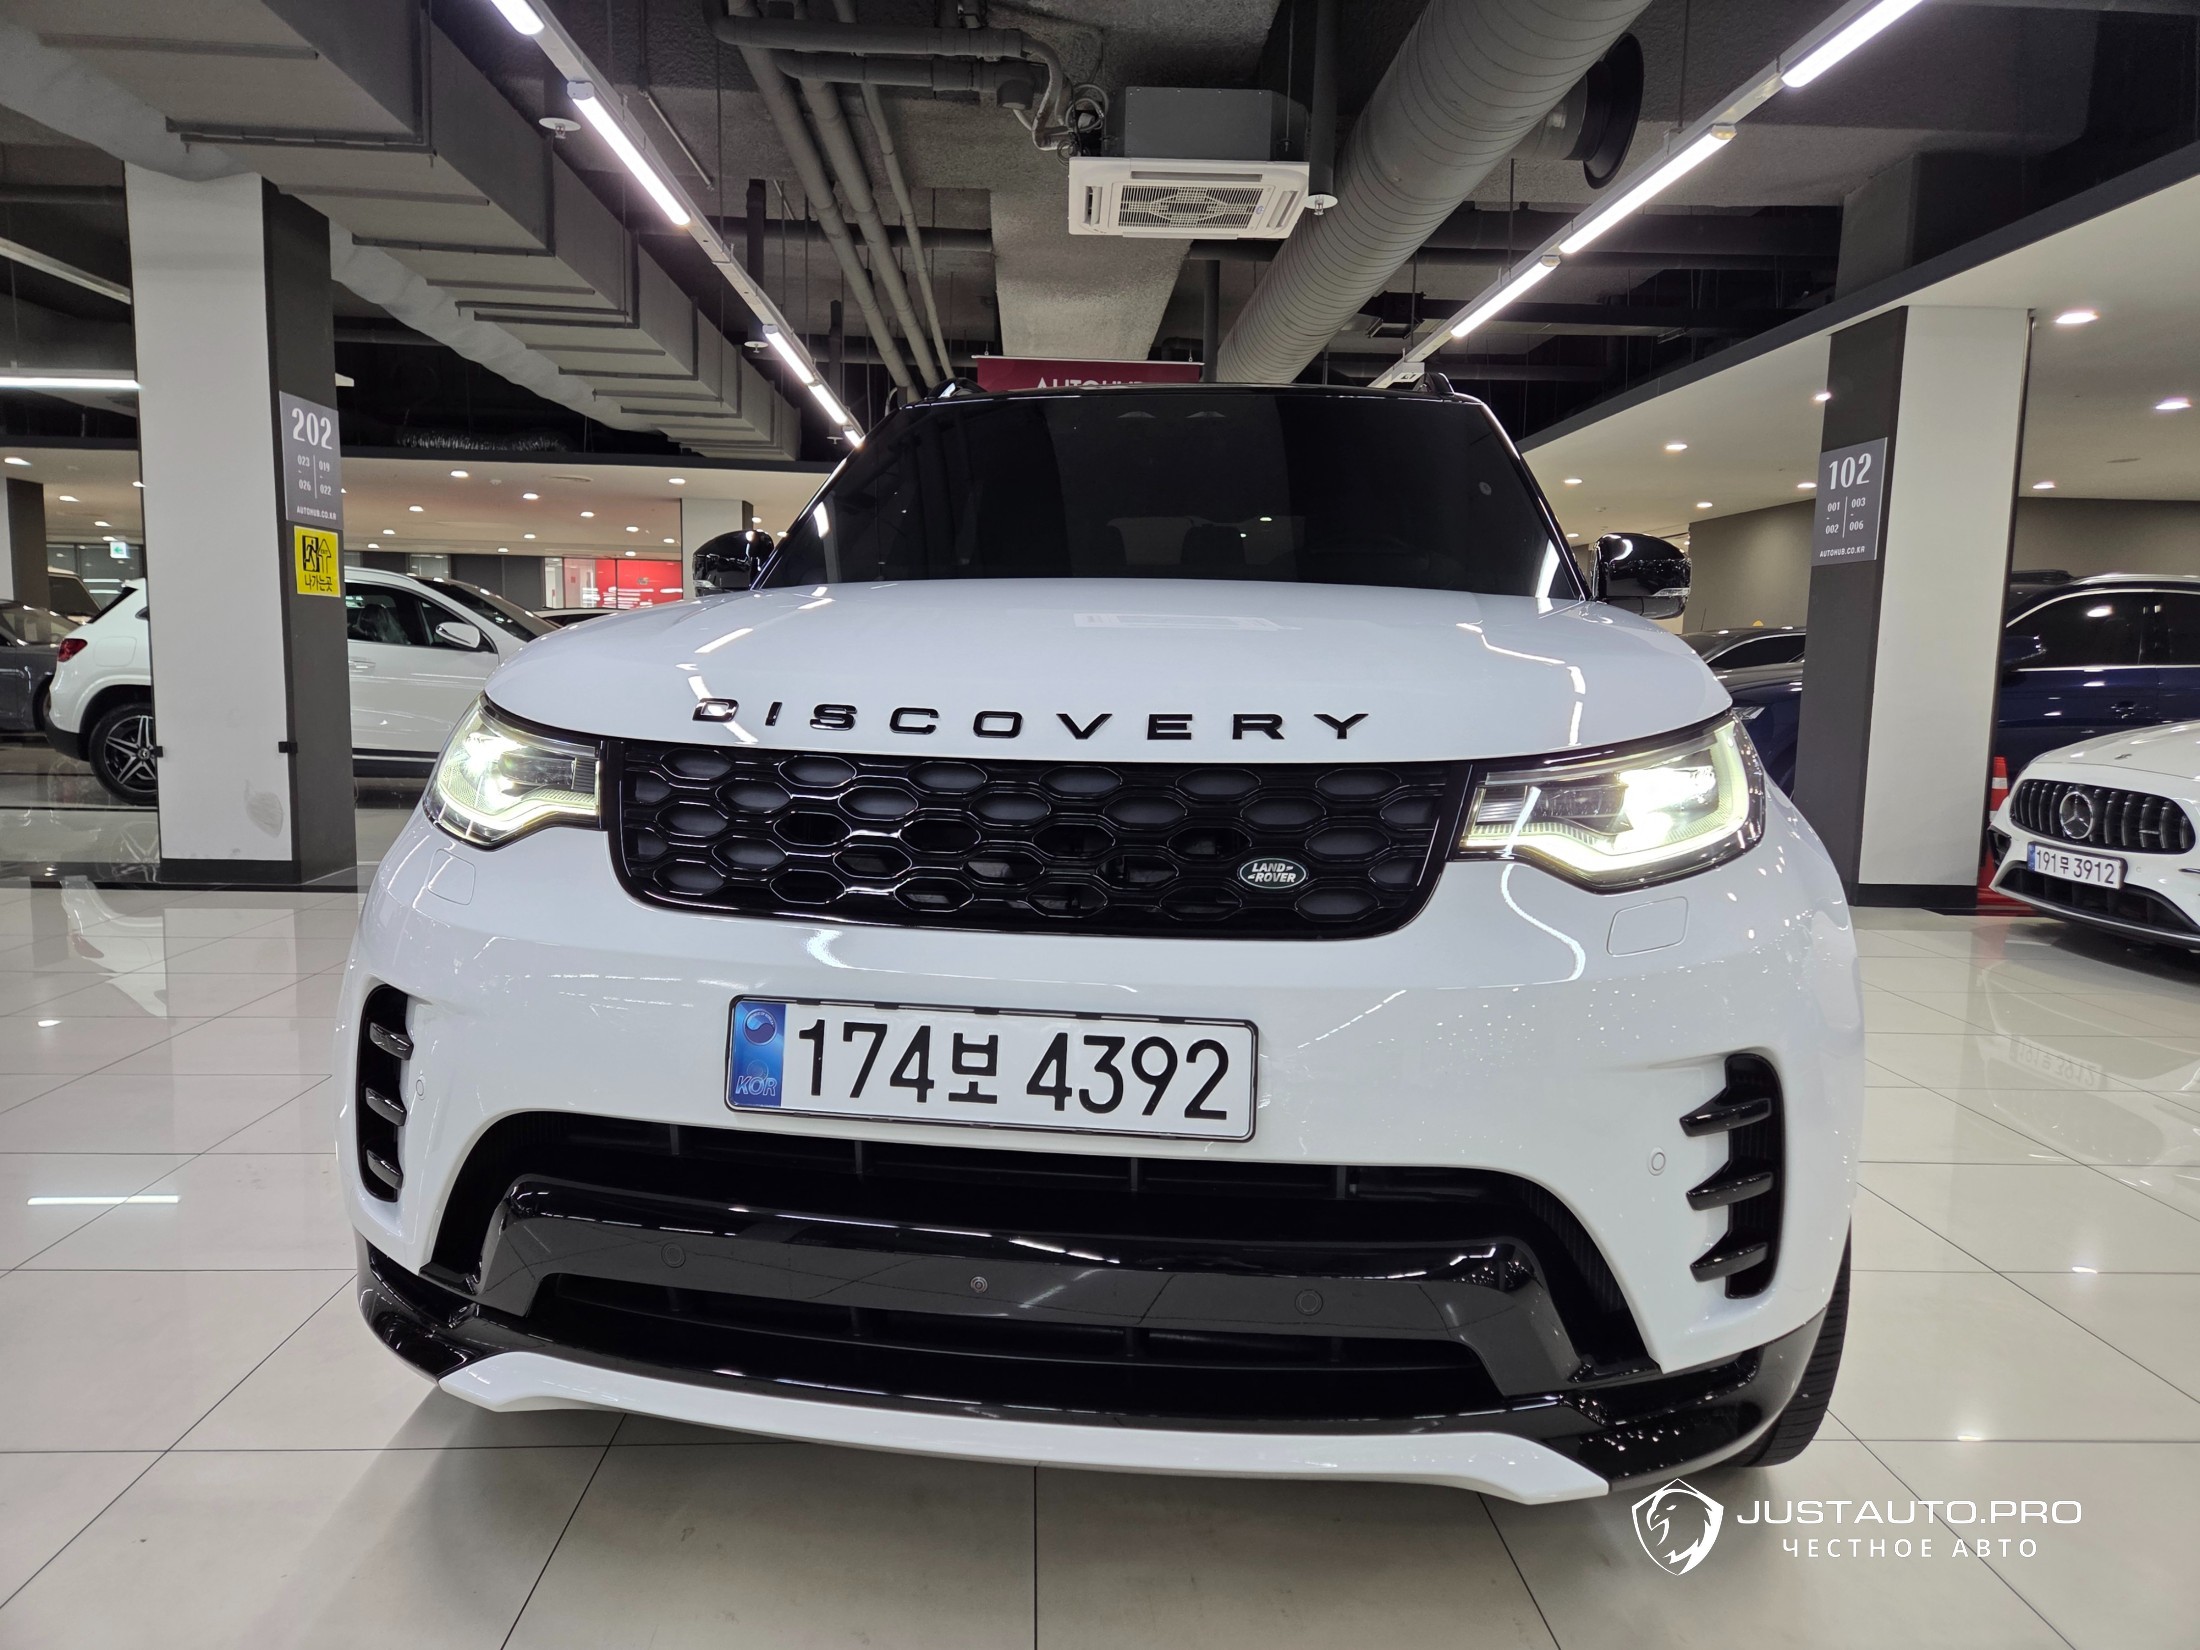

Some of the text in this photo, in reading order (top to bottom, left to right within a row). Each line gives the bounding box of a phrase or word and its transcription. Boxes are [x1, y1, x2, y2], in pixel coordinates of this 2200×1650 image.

[291, 407, 333, 450] 202
[297, 454, 310, 467] 023
[319, 460, 330, 472] 019
[1828, 453, 1872, 490] 102
[298, 478, 311, 491] 026
[319, 484, 331, 496] 022
[1827, 501, 1840, 512] 001
[1851, 497, 1866, 508] 003
[1825, 523, 1839, 534] 002
[1849, 520, 1864, 531] 006
[1819, 545, 1865, 558] AUTOHUB.CO.KR
[691, 697, 1369, 741] DISCOVERY
[1251, 862, 1286, 873] LAND
[2036, 850, 2115, 885] 191무 3912
[1254, 872, 1297, 883] ROVER
[799, 1019, 1230, 1121] 174보 4392
[735, 1075, 777, 1097] KOR
